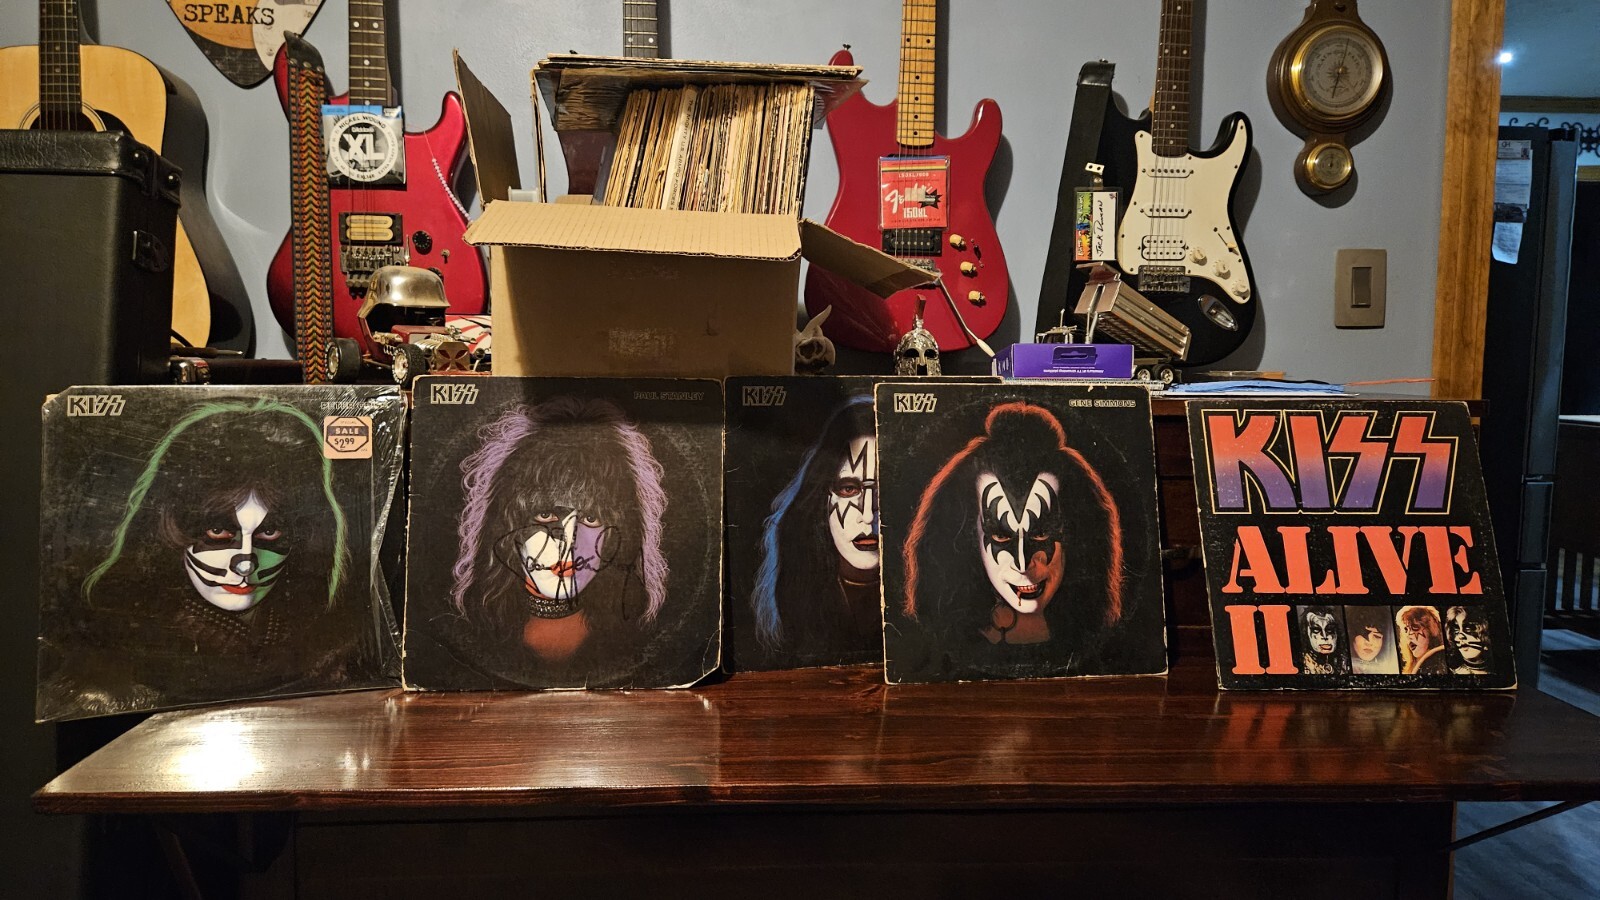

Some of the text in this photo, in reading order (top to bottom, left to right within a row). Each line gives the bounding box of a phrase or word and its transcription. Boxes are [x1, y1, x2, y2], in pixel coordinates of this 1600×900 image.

[184, 4, 275, 26] SPEAKS
[342, 133, 385, 160] XL
[430, 383, 479, 405] KISS
[633, 391, 705, 401] PAUL STANLEY
[742, 386, 787, 407] KISS
[894, 393, 937, 412] KISS
[1068, 398, 1137, 408] GENE SIMMONS
[67, 395, 126, 417] KISS
[335, 427, 359, 435] SALE
[1201, 409, 1459, 515] KISS
[1222, 526, 1484, 595] ALIVE
[1225, 604, 1299, 675] II
